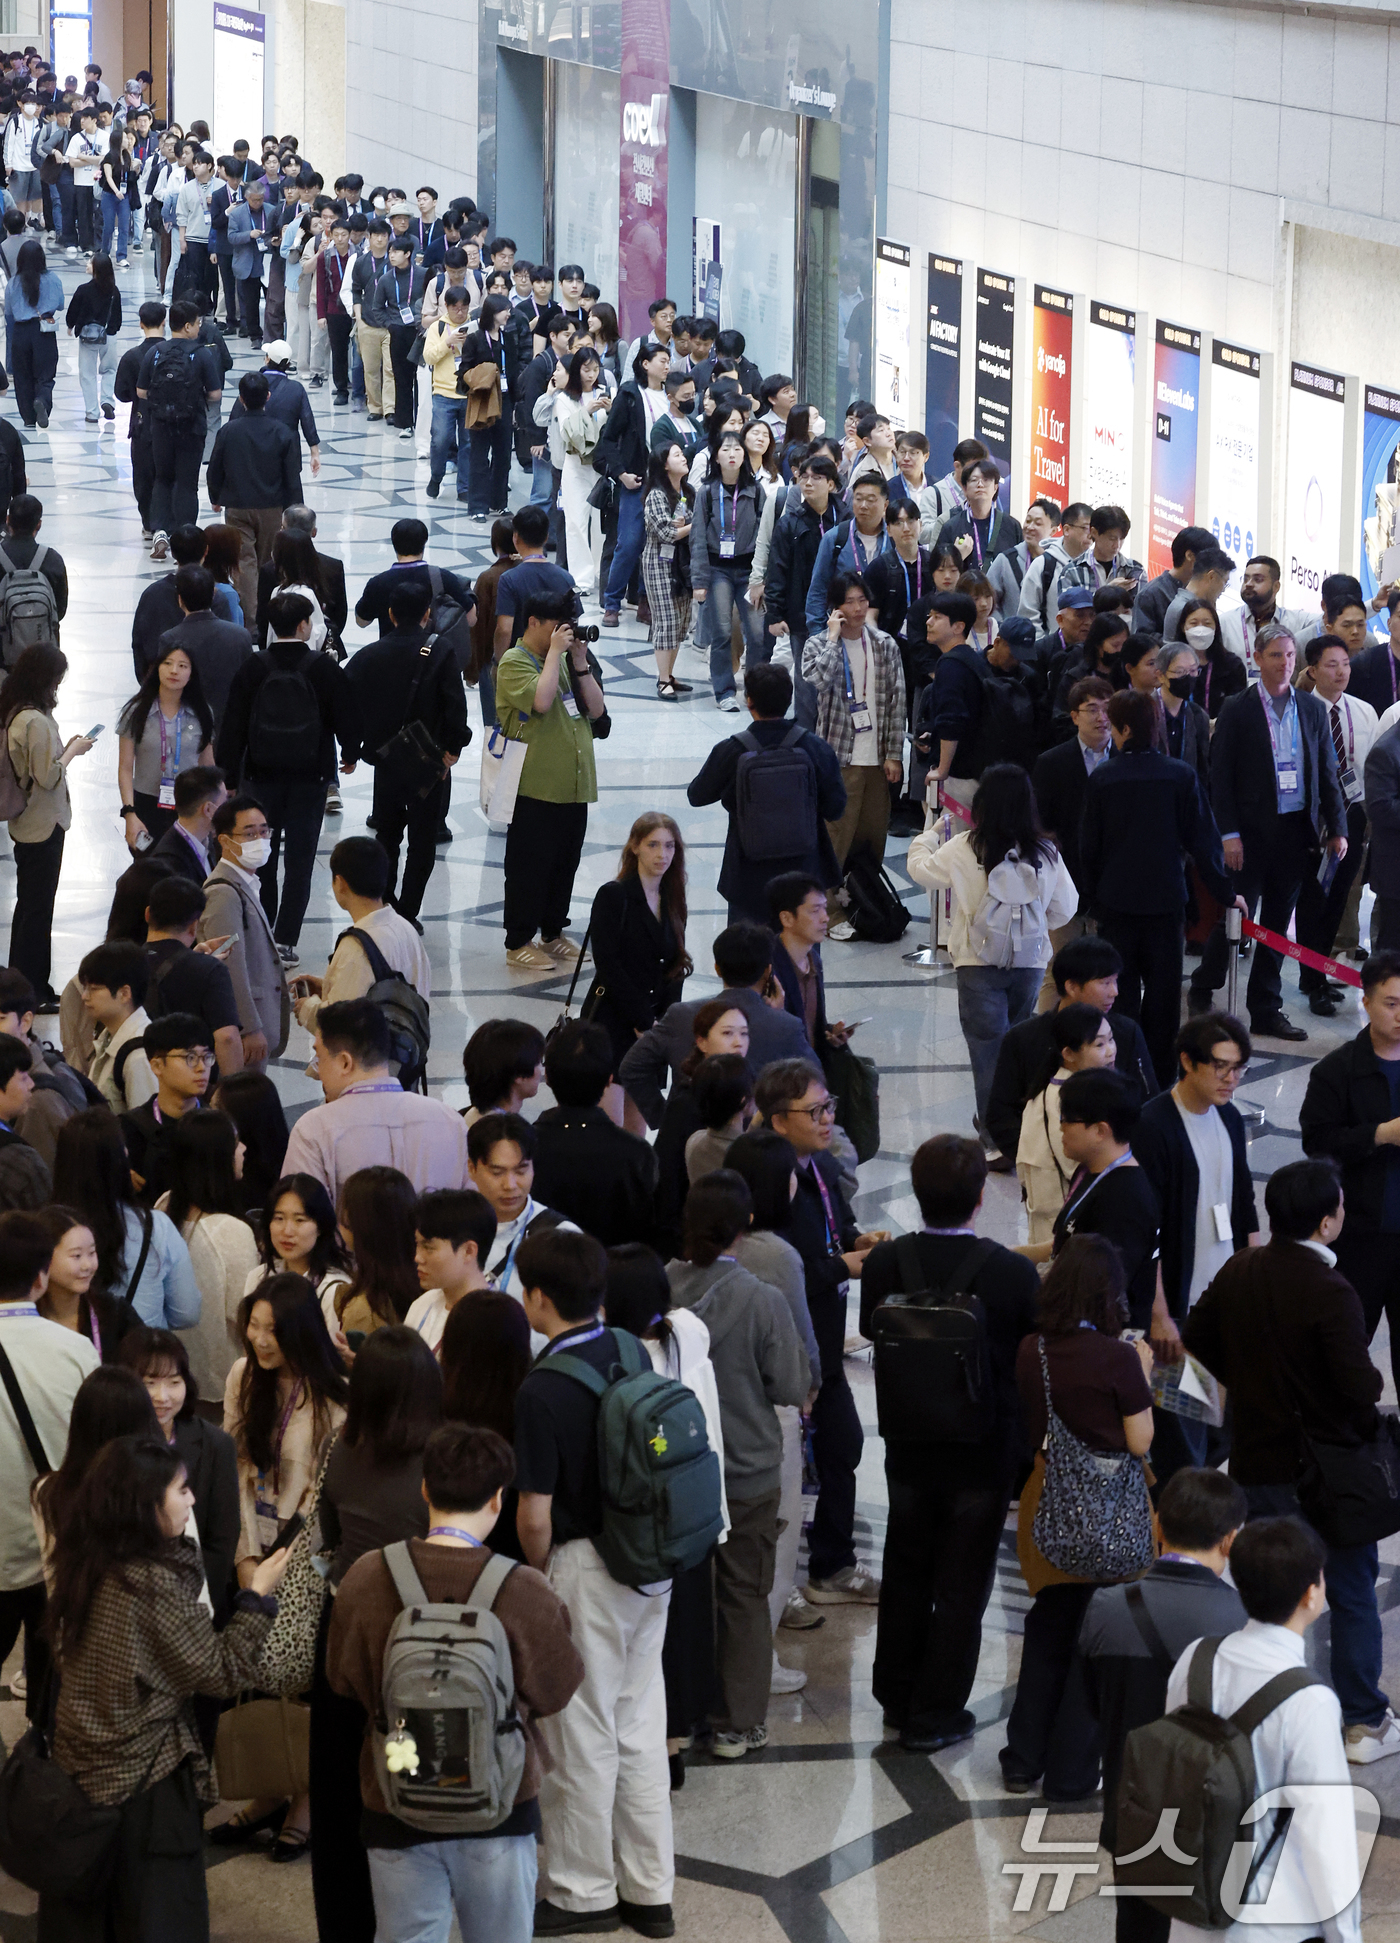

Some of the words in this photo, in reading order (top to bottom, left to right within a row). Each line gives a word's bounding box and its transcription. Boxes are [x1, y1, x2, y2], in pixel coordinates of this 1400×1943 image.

[623, 93, 667, 148] coex
[1036, 405, 1049, 438] AI
[1049, 409, 1065, 444] for
[1158, 418, 1170, 436] D-11
[1034, 445, 1066, 487] Travel
[1290, 556, 1320, 592] Perso
